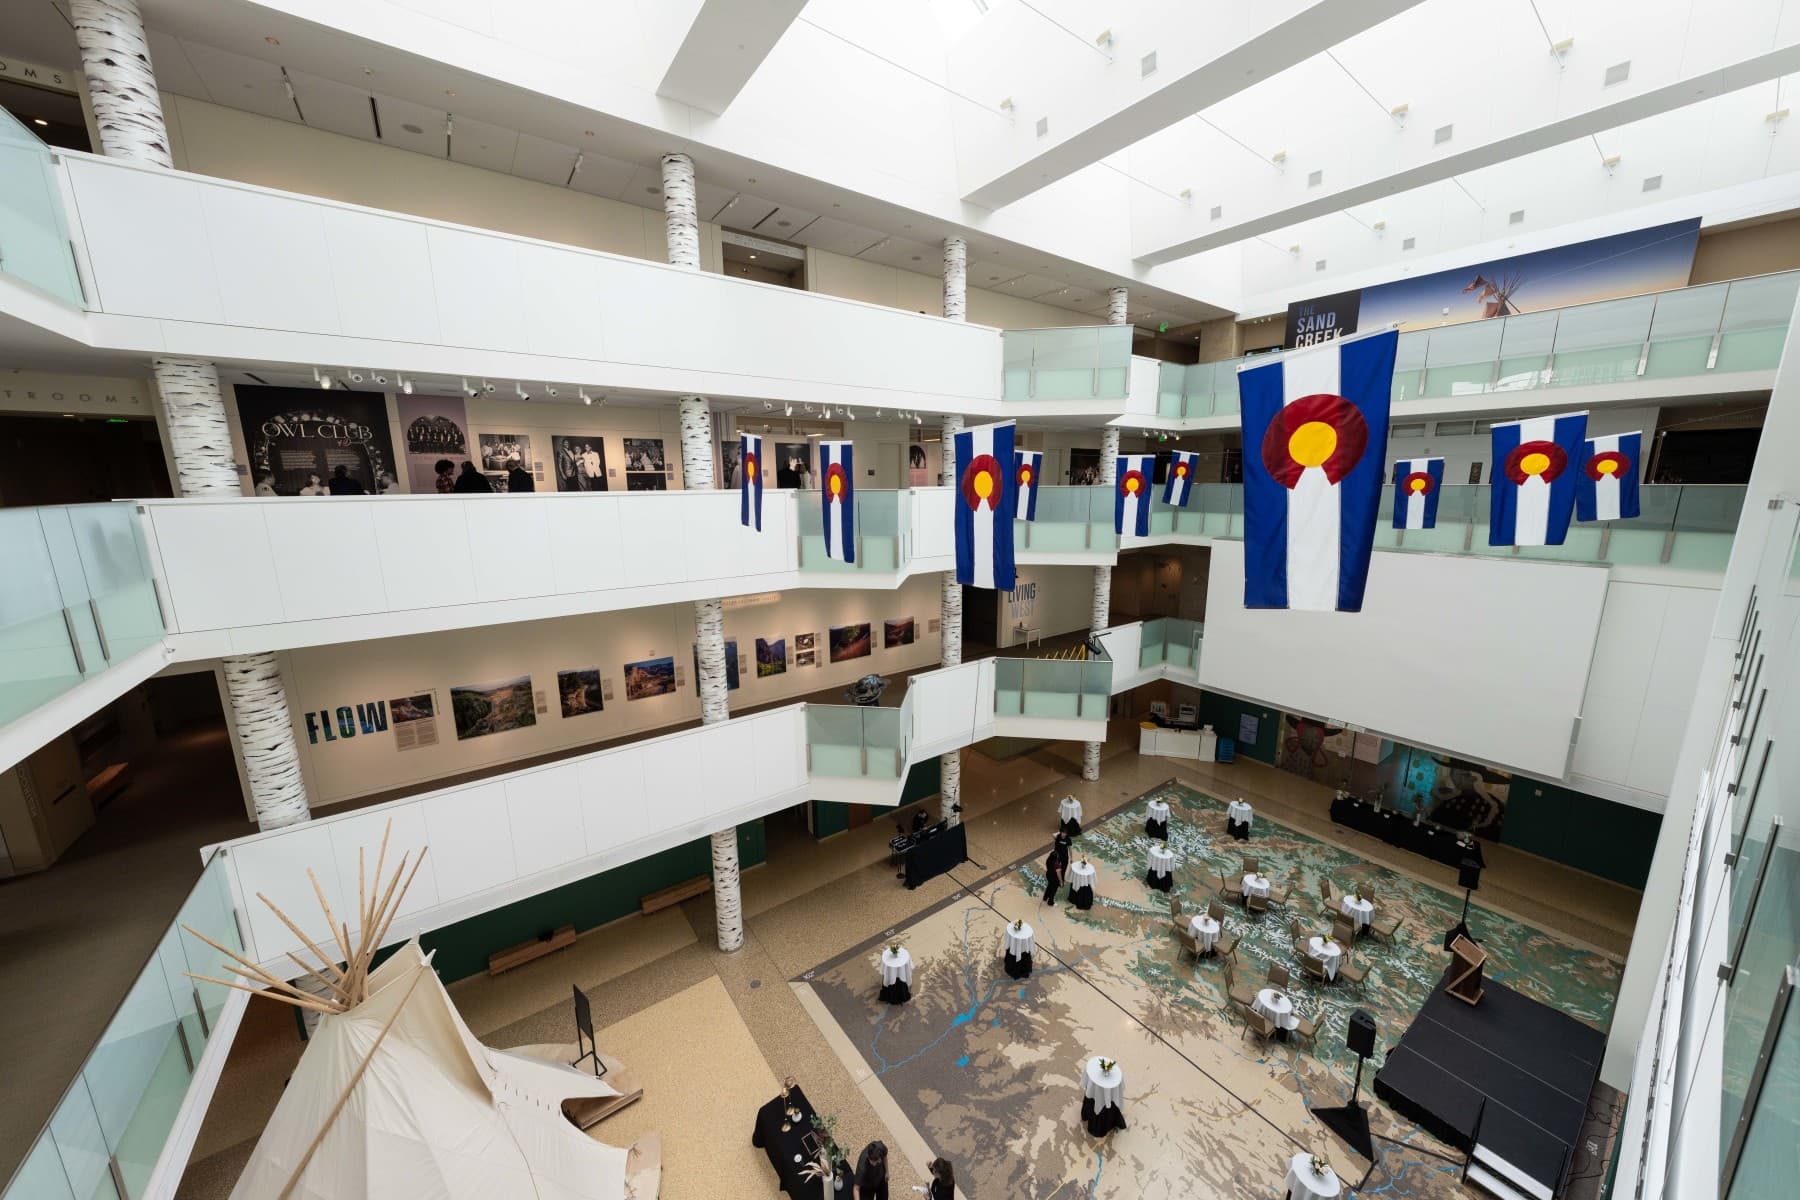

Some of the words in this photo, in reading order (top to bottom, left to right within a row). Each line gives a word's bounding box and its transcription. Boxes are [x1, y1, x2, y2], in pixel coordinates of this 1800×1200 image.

[1297, 312, 1336, 333] SAND
[1295, 327, 1344, 349] CREEK
[262, 422, 315, 438] OWL
[317, 424, 373, 440] CLUB
[304, 700, 389, 745] FLOW
